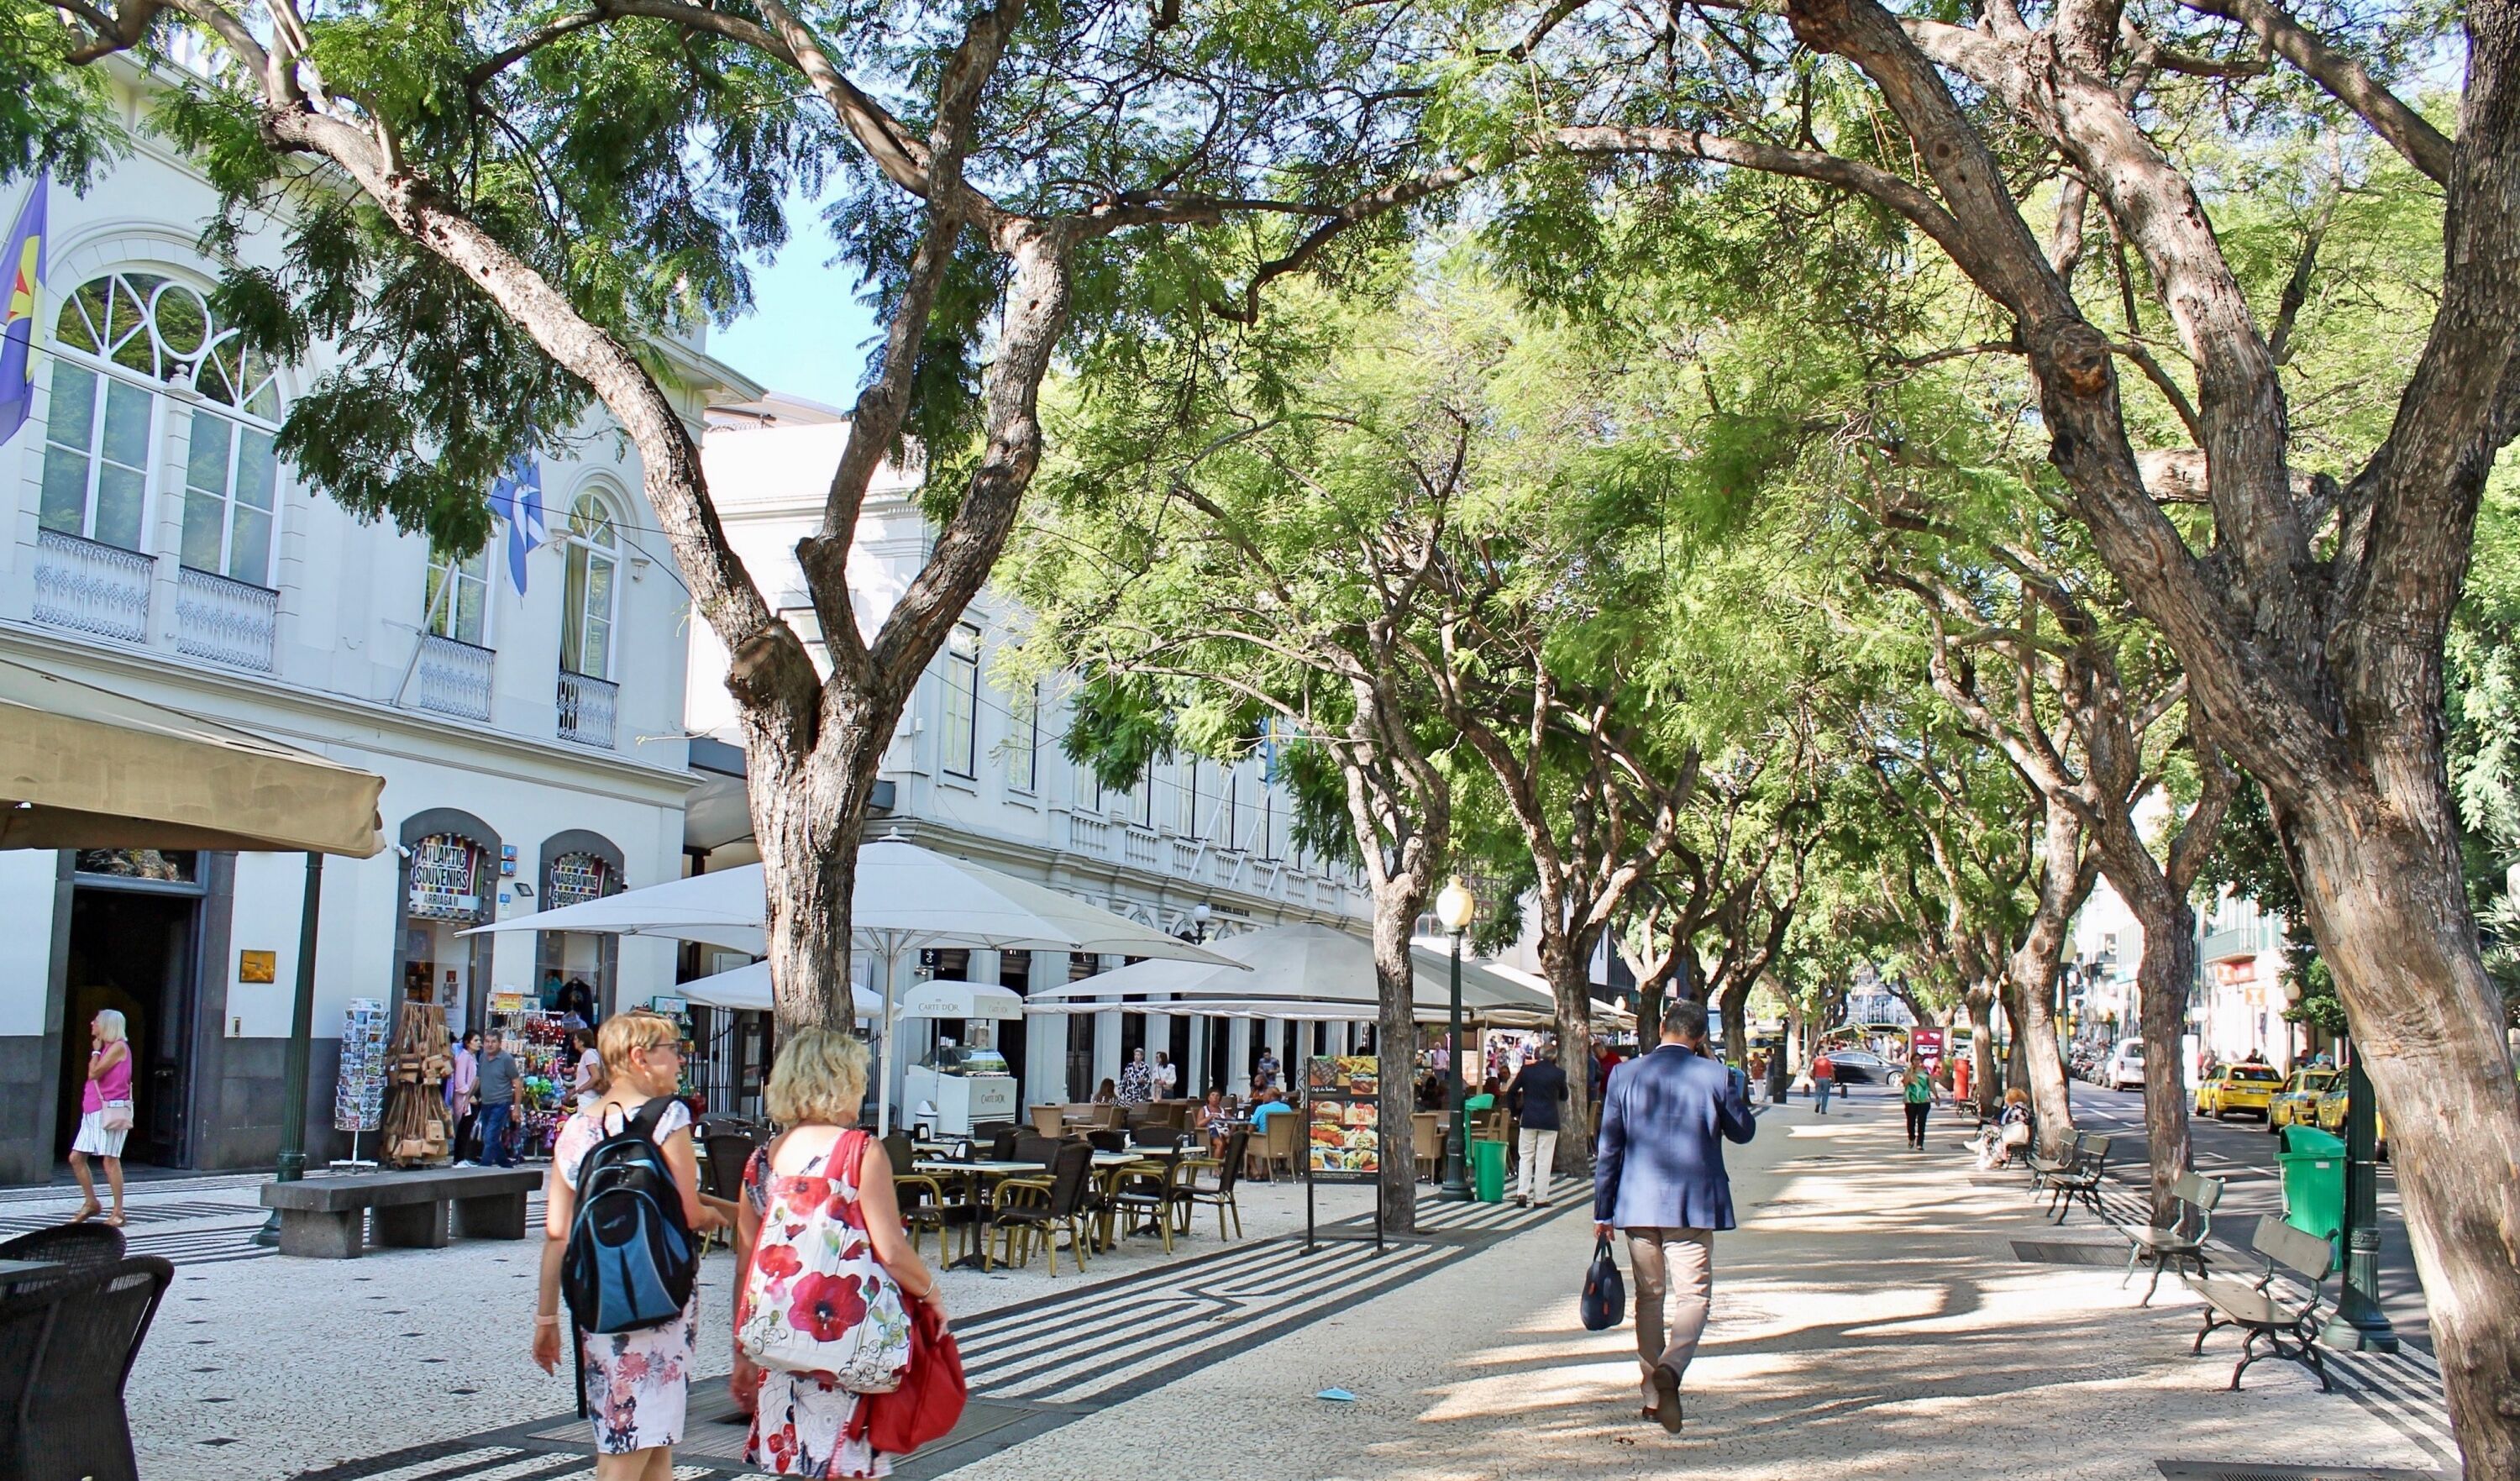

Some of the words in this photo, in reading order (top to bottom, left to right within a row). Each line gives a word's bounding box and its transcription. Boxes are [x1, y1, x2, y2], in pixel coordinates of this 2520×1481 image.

[421, 844, 465, 867] ATLANTIC
[416, 866, 468, 889] SOUVENIRS
[554, 873, 581, 886] MADEIRA
[582, 875, 597, 888] WINE
[423, 894, 451, 906] ARRIAGA
[918, 1003, 940, 1012] CARTE
[942, 1003, 960, 1012] D'OR
